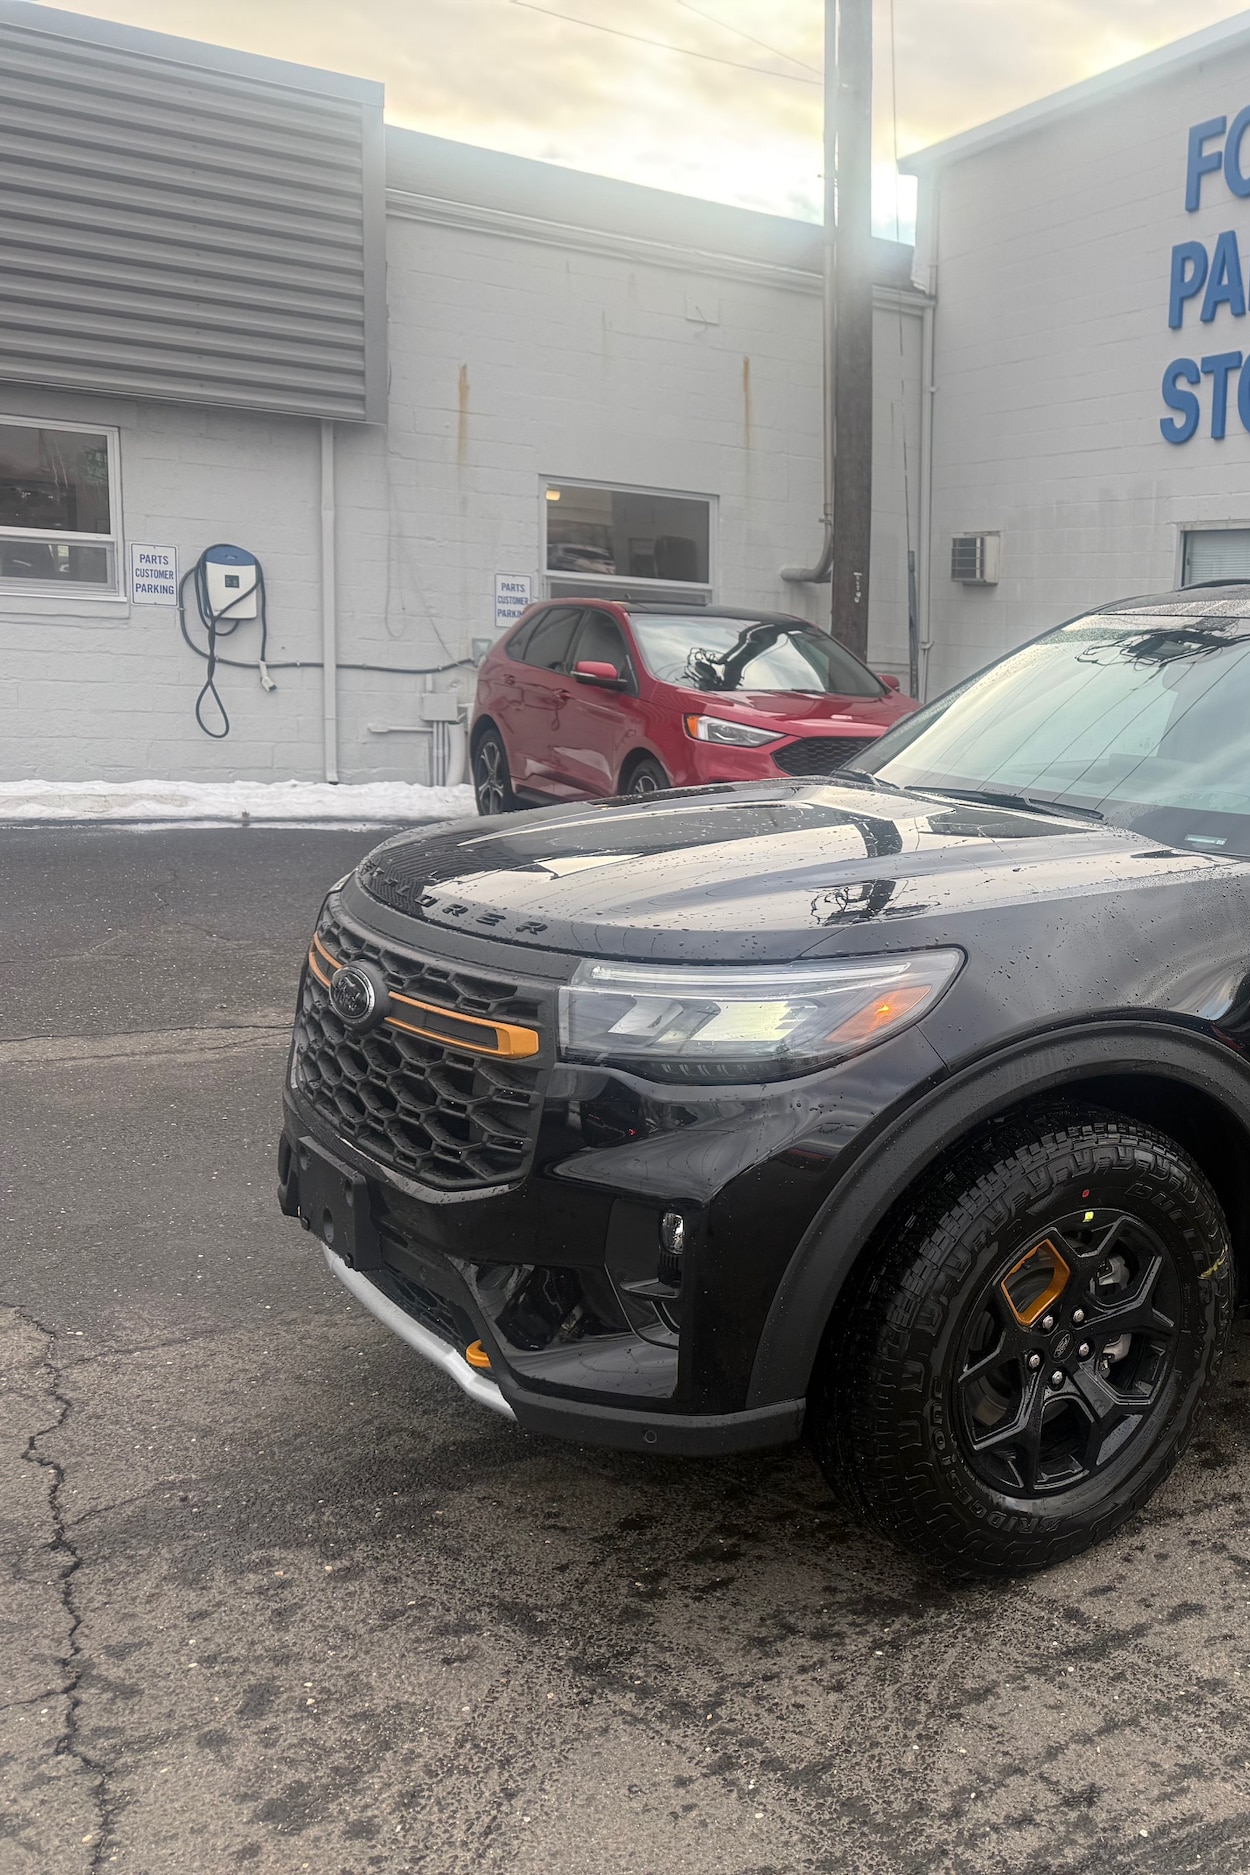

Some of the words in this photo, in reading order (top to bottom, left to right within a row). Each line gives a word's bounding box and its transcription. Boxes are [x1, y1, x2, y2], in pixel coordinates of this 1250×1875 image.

[139, 553, 169, 566] PARTS
[135, 568, 174, 580] CUSTOMER
[135, 583, 175, 595] PARKING
[501, 582, 525, 593] PARTS
[497, 595, 529, 605] CUSTOMER
